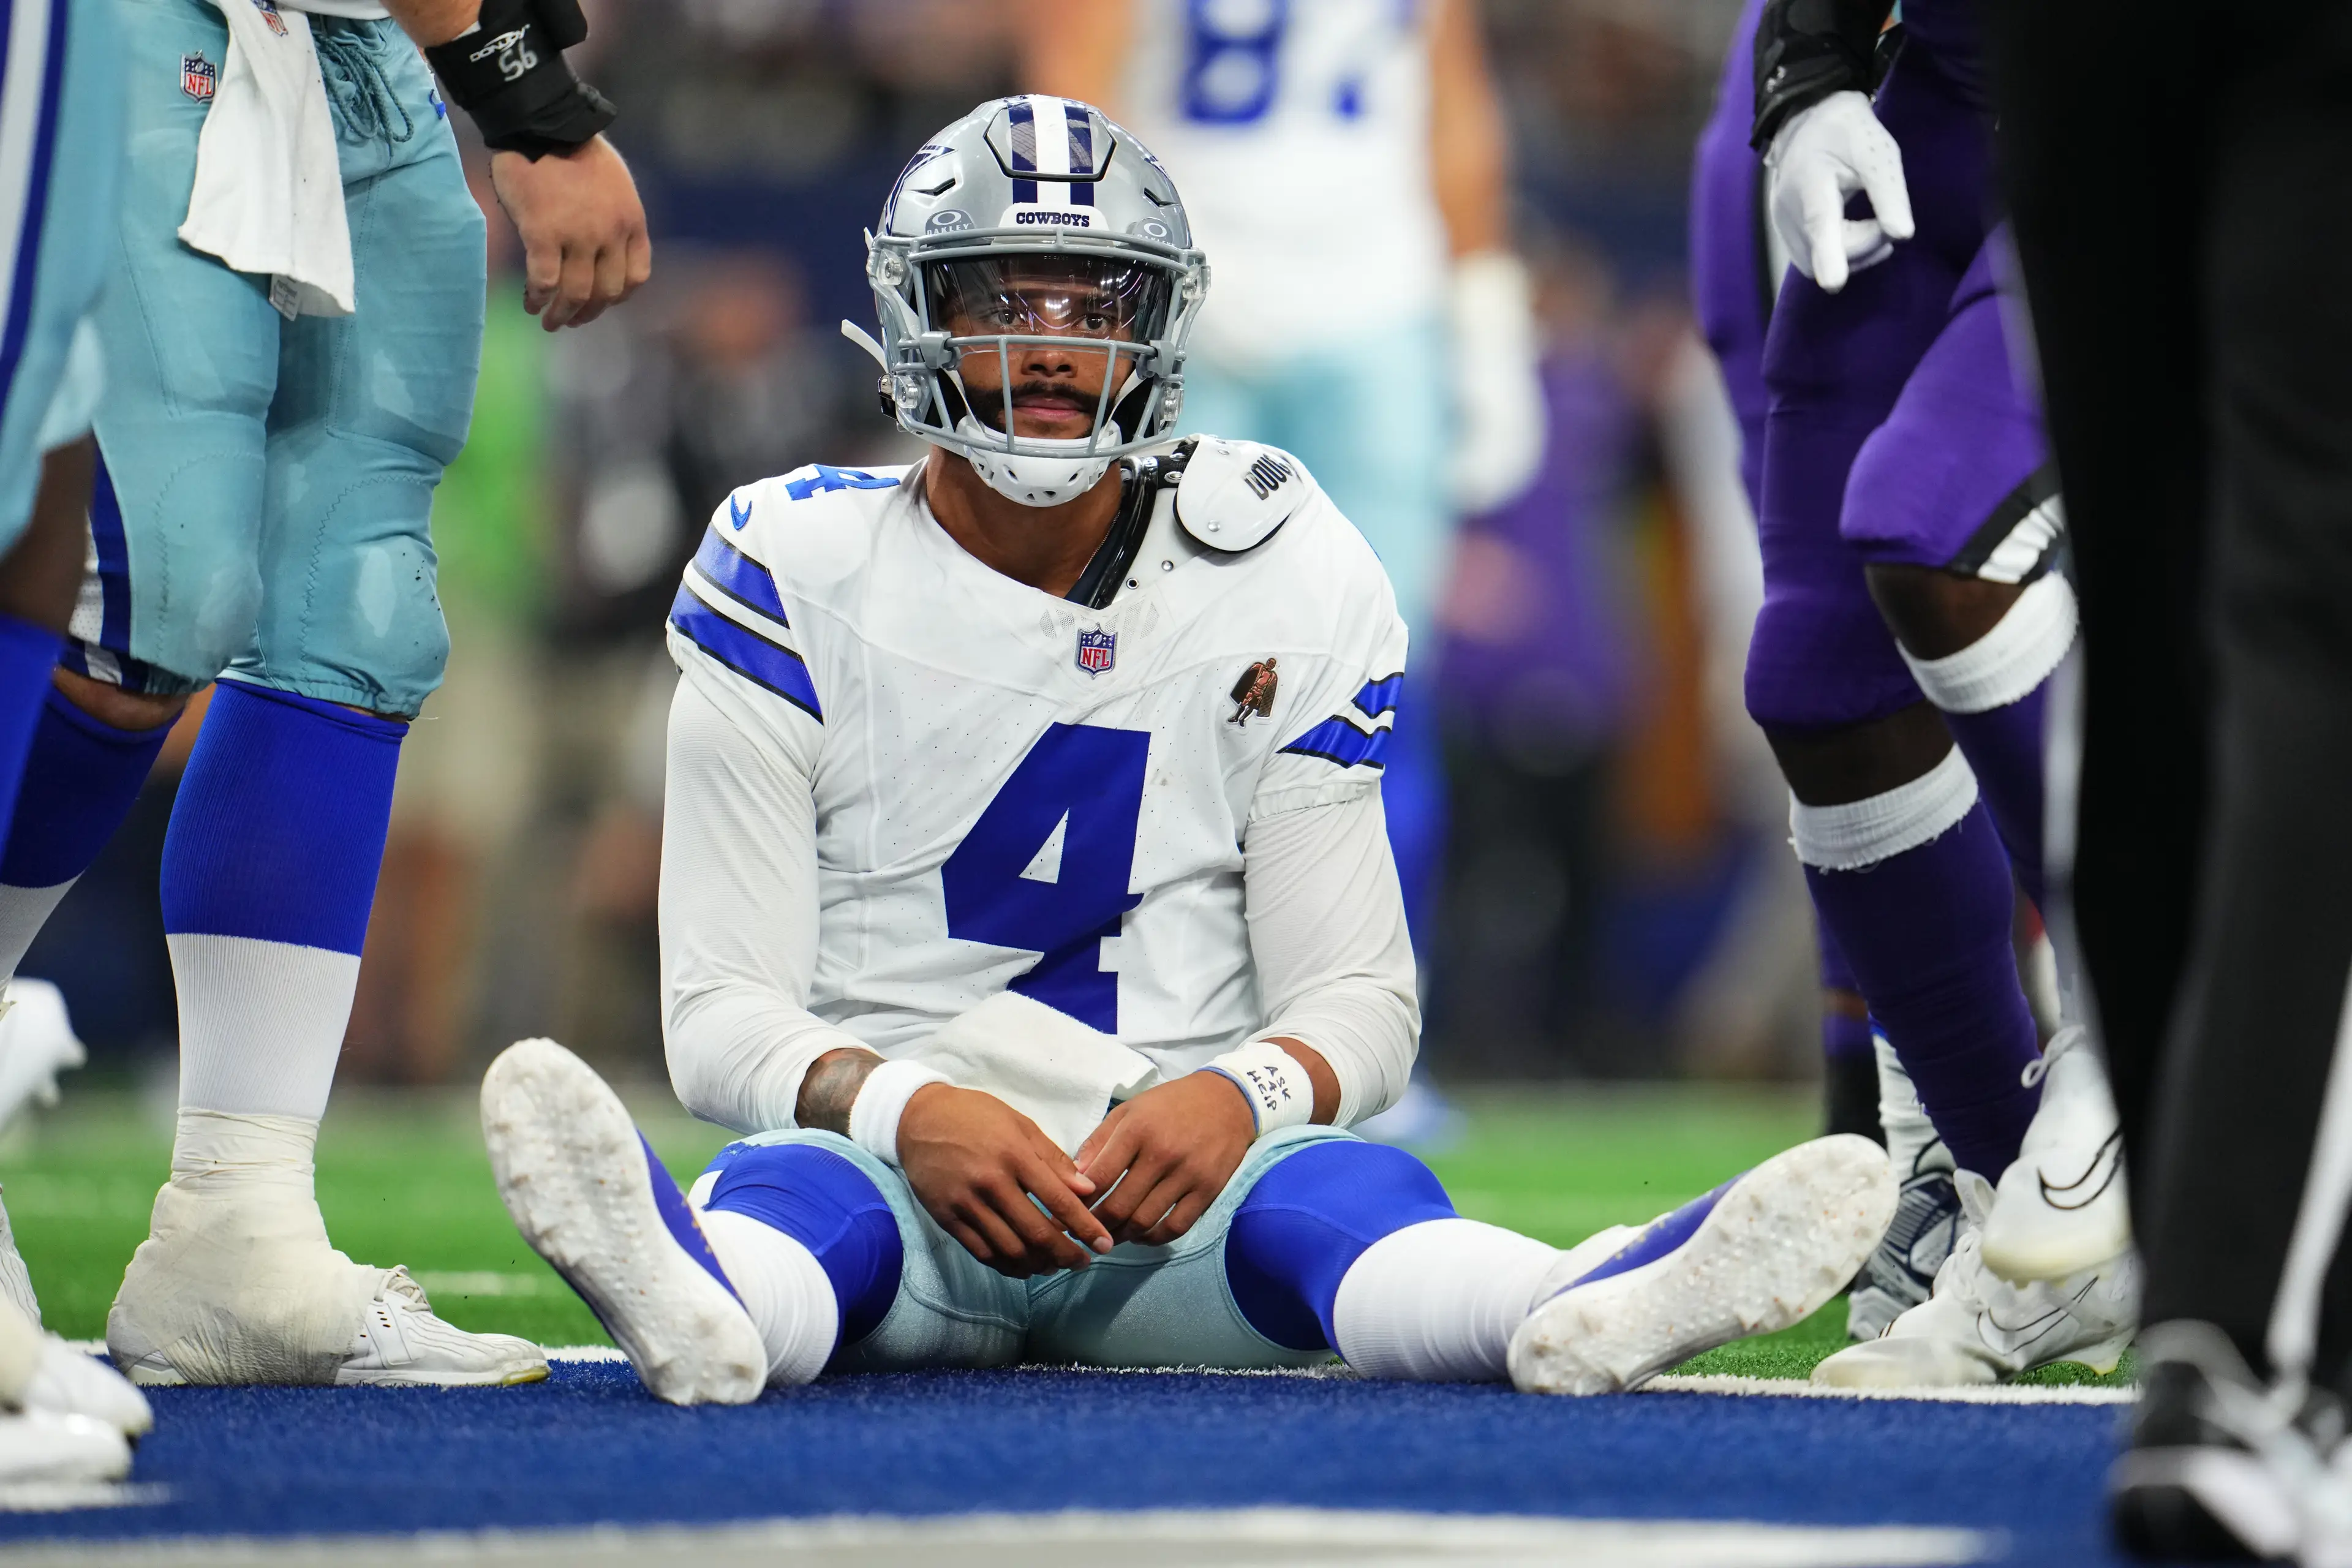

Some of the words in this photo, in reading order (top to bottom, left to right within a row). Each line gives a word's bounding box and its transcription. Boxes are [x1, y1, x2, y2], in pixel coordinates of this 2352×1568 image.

[499, 40, 538, 81] 56
[187, 74, 213, 96] NFL
[927, 223, 970, 236] OAKLEY
[1016, 212, 1090, 227] COWBOYS
[785, 464, 901, 501] 4
[1081, 647, 1110, 669] NFL
[941, 722, 1152, 1035] 4
[1264, 1065, 1291, 1101] ASK
[1268, 1080, 1277, 1091] 4
